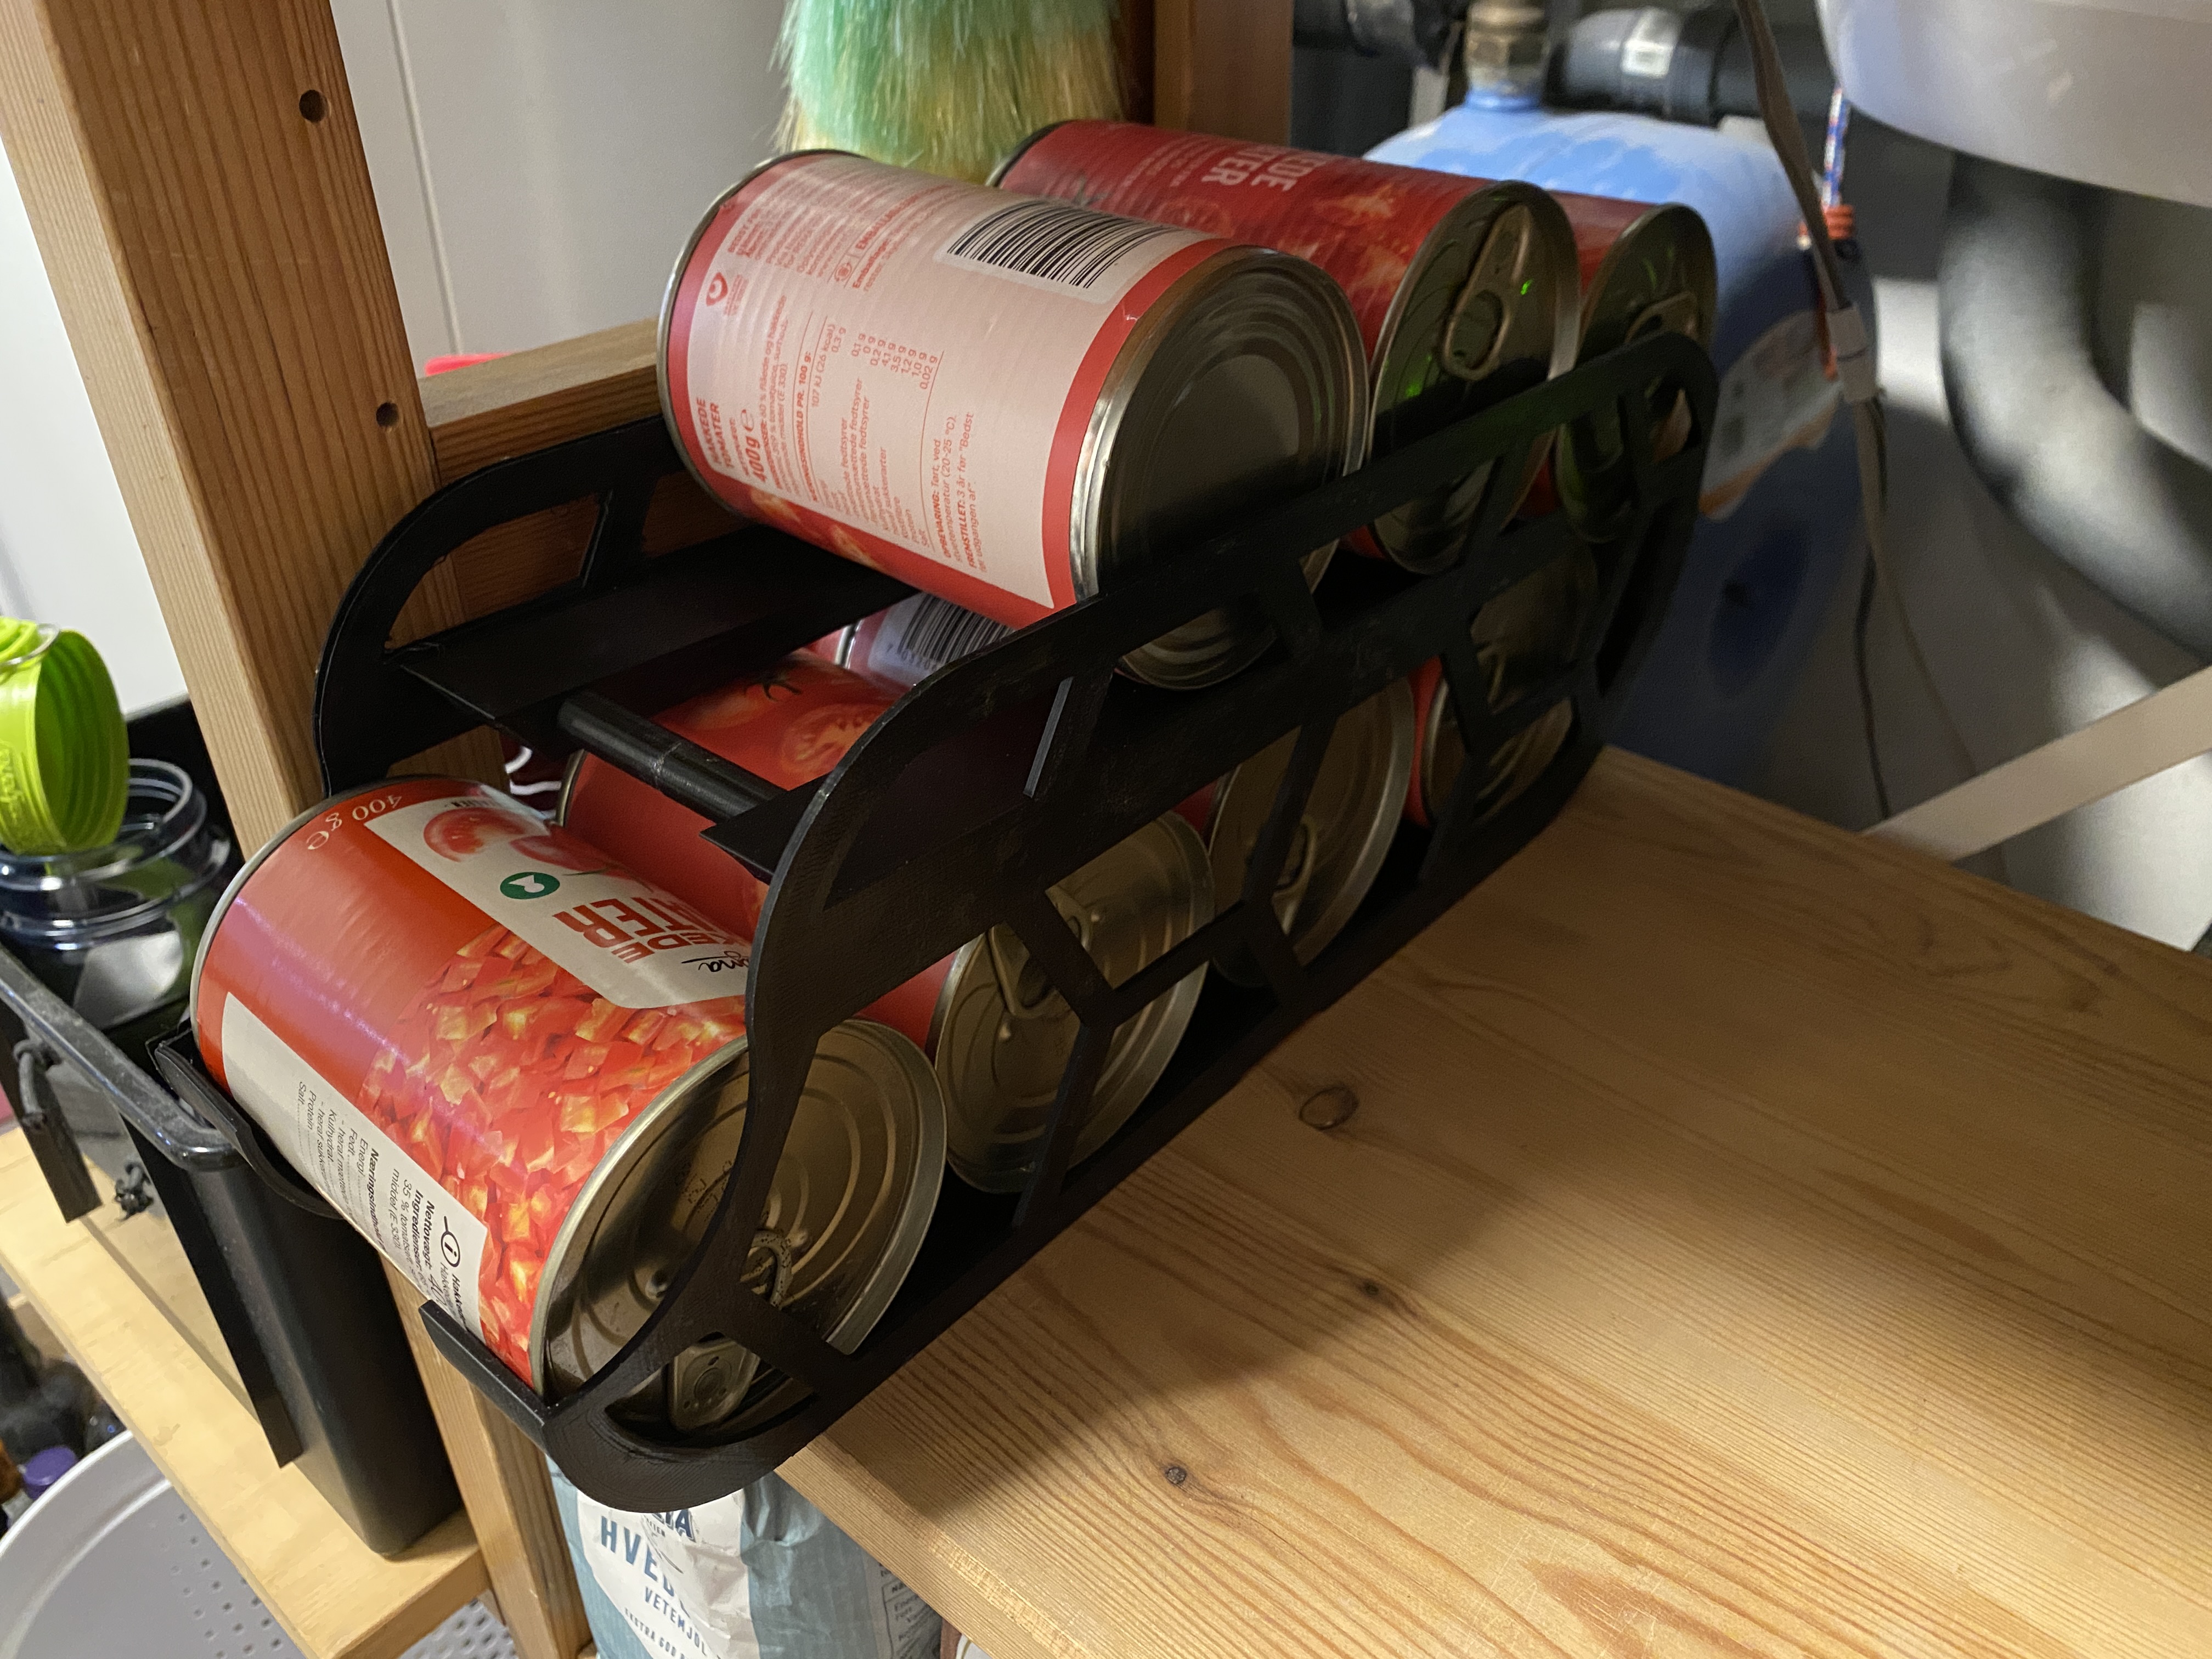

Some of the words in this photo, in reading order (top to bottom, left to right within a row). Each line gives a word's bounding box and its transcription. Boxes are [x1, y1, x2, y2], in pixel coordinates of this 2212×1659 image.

[799, 365, 808, 385] 100
[850, 377, 862, 430] fedtsyrer
[859, 396, 870, 450] fedtsyrer
[940, 439, 952, 478] (20-25
[957, 454, 966, 473] før
[932, 488, 951, 558] OPBEVARING:
[957, 499, 977, 568] FREMSTILLET:
[969, 503, 984, 556] udgangen
[325, 812, 343, 832] g
[352, 795, 402, 821] 400
[298, 1081, 307, 1105] Salt
[307, 1090, 317, 1130] Protein
[317, 1108, 325, 1141] heraf
[326, 1109, 337, 1163] Kulhydrat
[337, 1127, 346, 1160] heraf
[348, 1127, 358, 1155] Fedt
[356, 1138, 368, 1177] Energi
[366, 1148, 383, 1240] Næringsindhold
[389, 1168, 400, 1212] middel
[400, 1200, 409, 1214] %
[402, 1179, 412, 1198] 35
